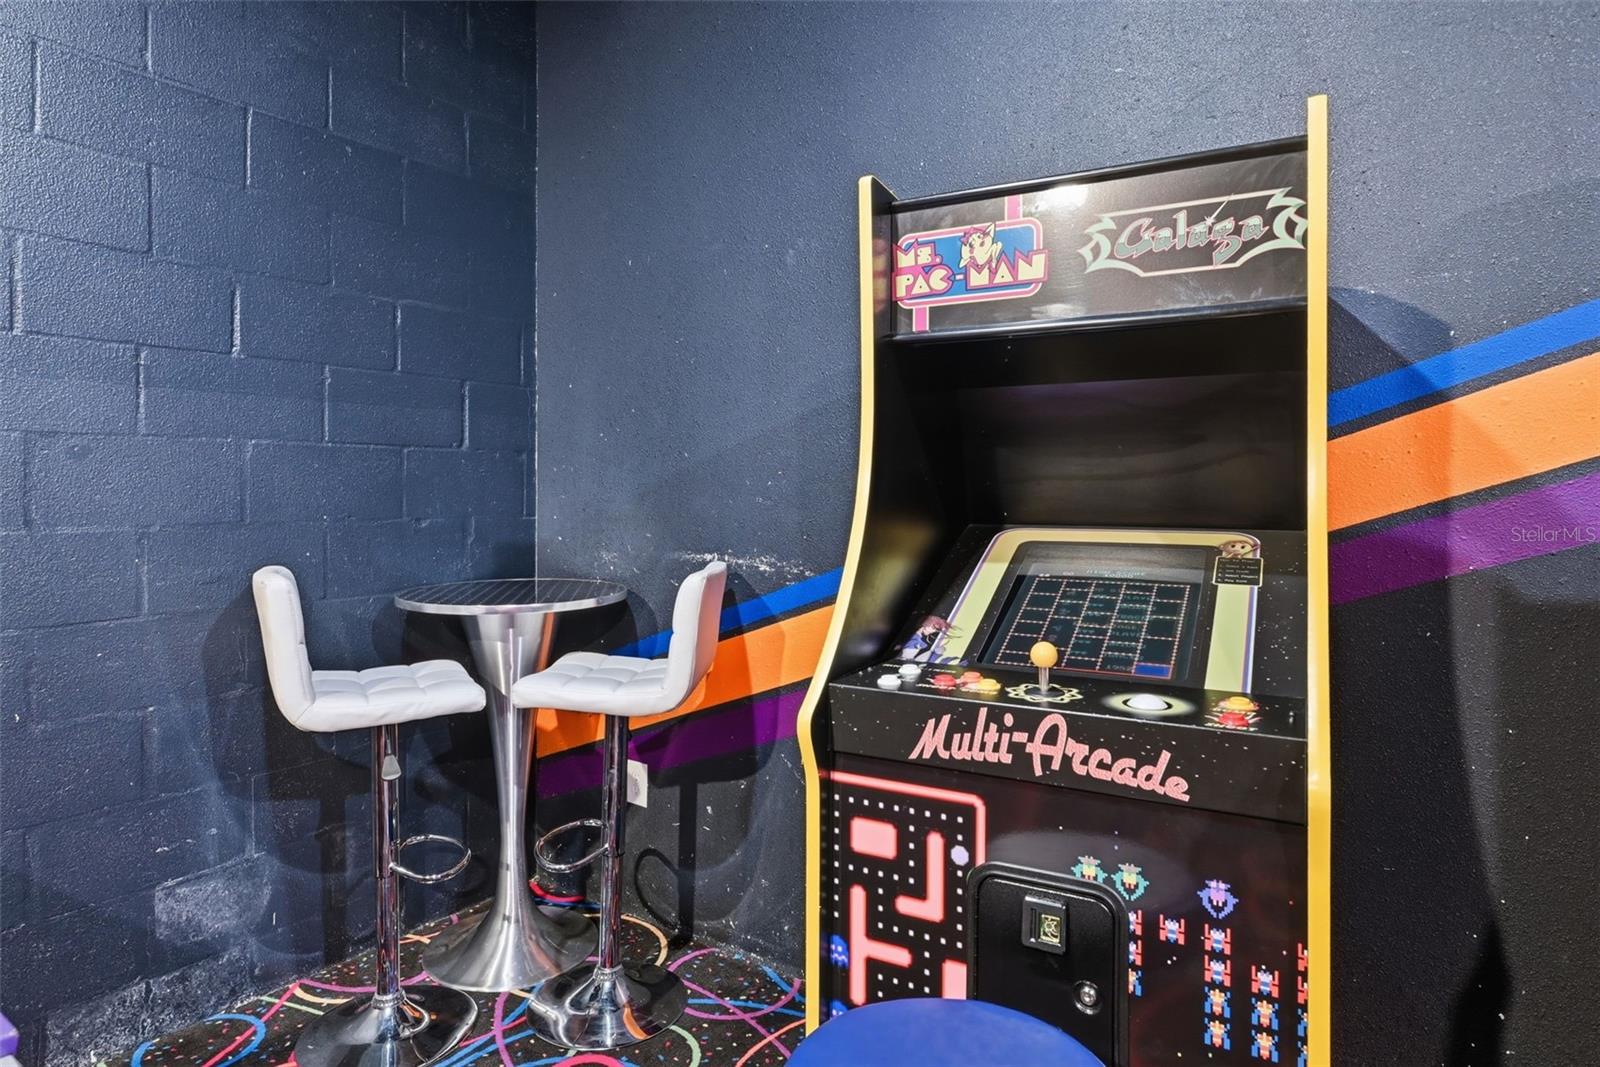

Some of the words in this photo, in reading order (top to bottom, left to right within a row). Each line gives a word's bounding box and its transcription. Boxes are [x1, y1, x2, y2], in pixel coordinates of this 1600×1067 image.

[1114, 209, 1269, 268] Galaga
[893, 250, 1048, 300] PAC-MAN
[908, 706, 1190, 802] Multi-Arcade
